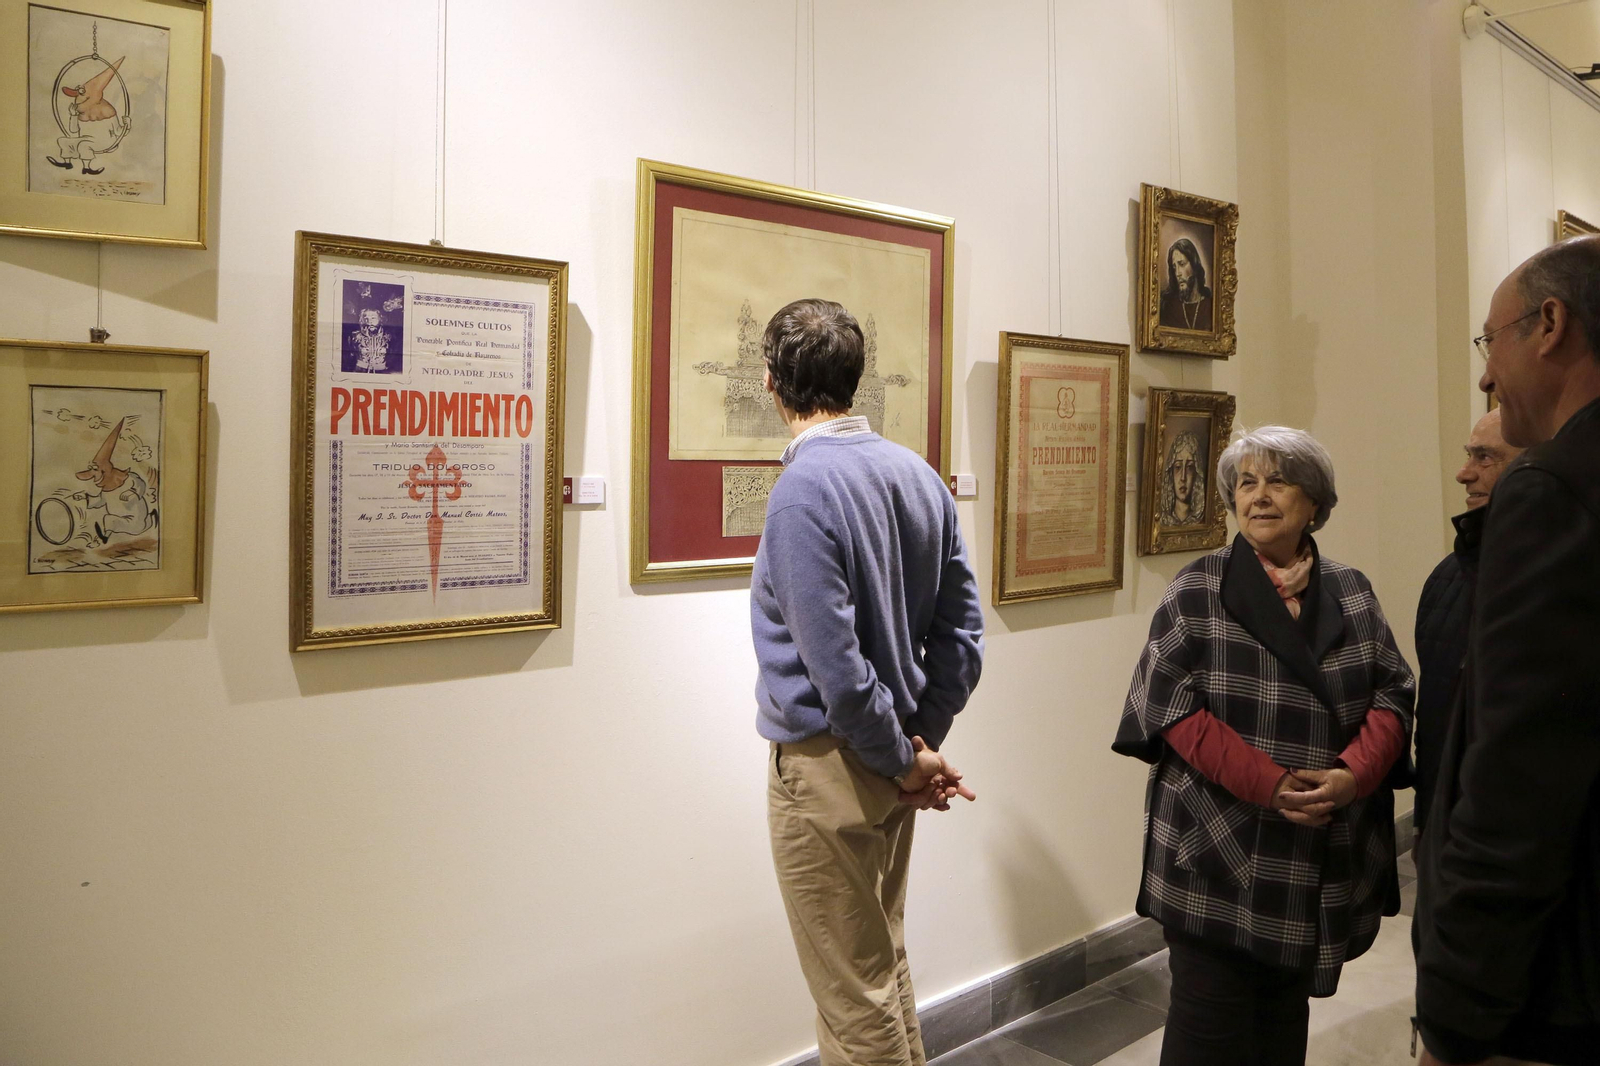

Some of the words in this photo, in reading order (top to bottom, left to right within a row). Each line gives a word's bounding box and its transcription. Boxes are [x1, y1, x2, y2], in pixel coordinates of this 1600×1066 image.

[426, 318, 474, 329] SOLEMNES
[478, 322, 512, 332] CULTOS
[422, 368, 452, 376] NTRO.
[454, 368, 484, 377] PADRE
[487, 371, 514, 379] JESUS
[330, 387, 533, 438] PRENDIMIENTO
[1032, 446, 1096, 465] PRENDIMIENTO
[401, 512, 422, 520] Doctor
